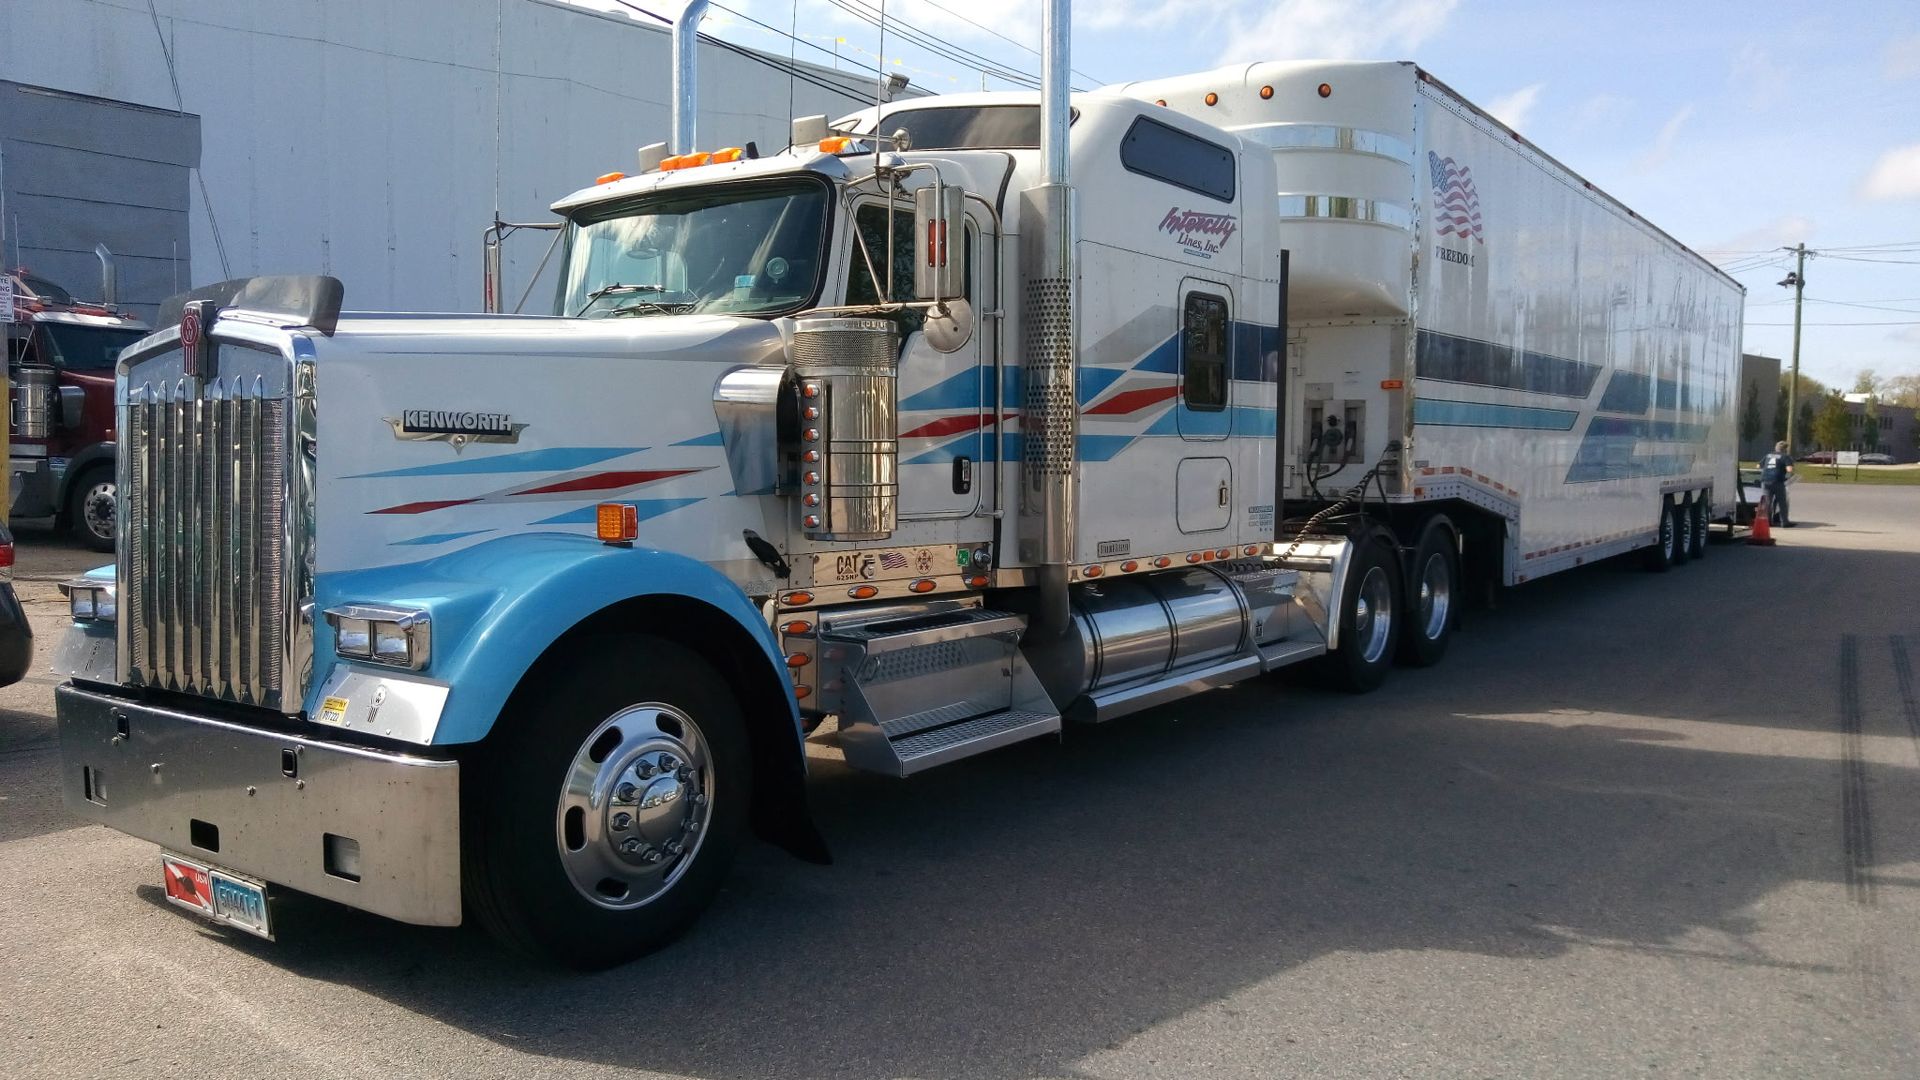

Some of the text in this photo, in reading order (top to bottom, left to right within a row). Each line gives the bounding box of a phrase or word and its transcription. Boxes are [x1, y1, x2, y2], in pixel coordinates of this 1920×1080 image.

[1158, 206, 1237, 249] Intercity
[1176, 232, 1203, 251] Lines,
[1203, 239, 1219, 254] Inc.
[403, 409, 512, 433] KENWORTH
[836, 552, 862, 574] CAT
